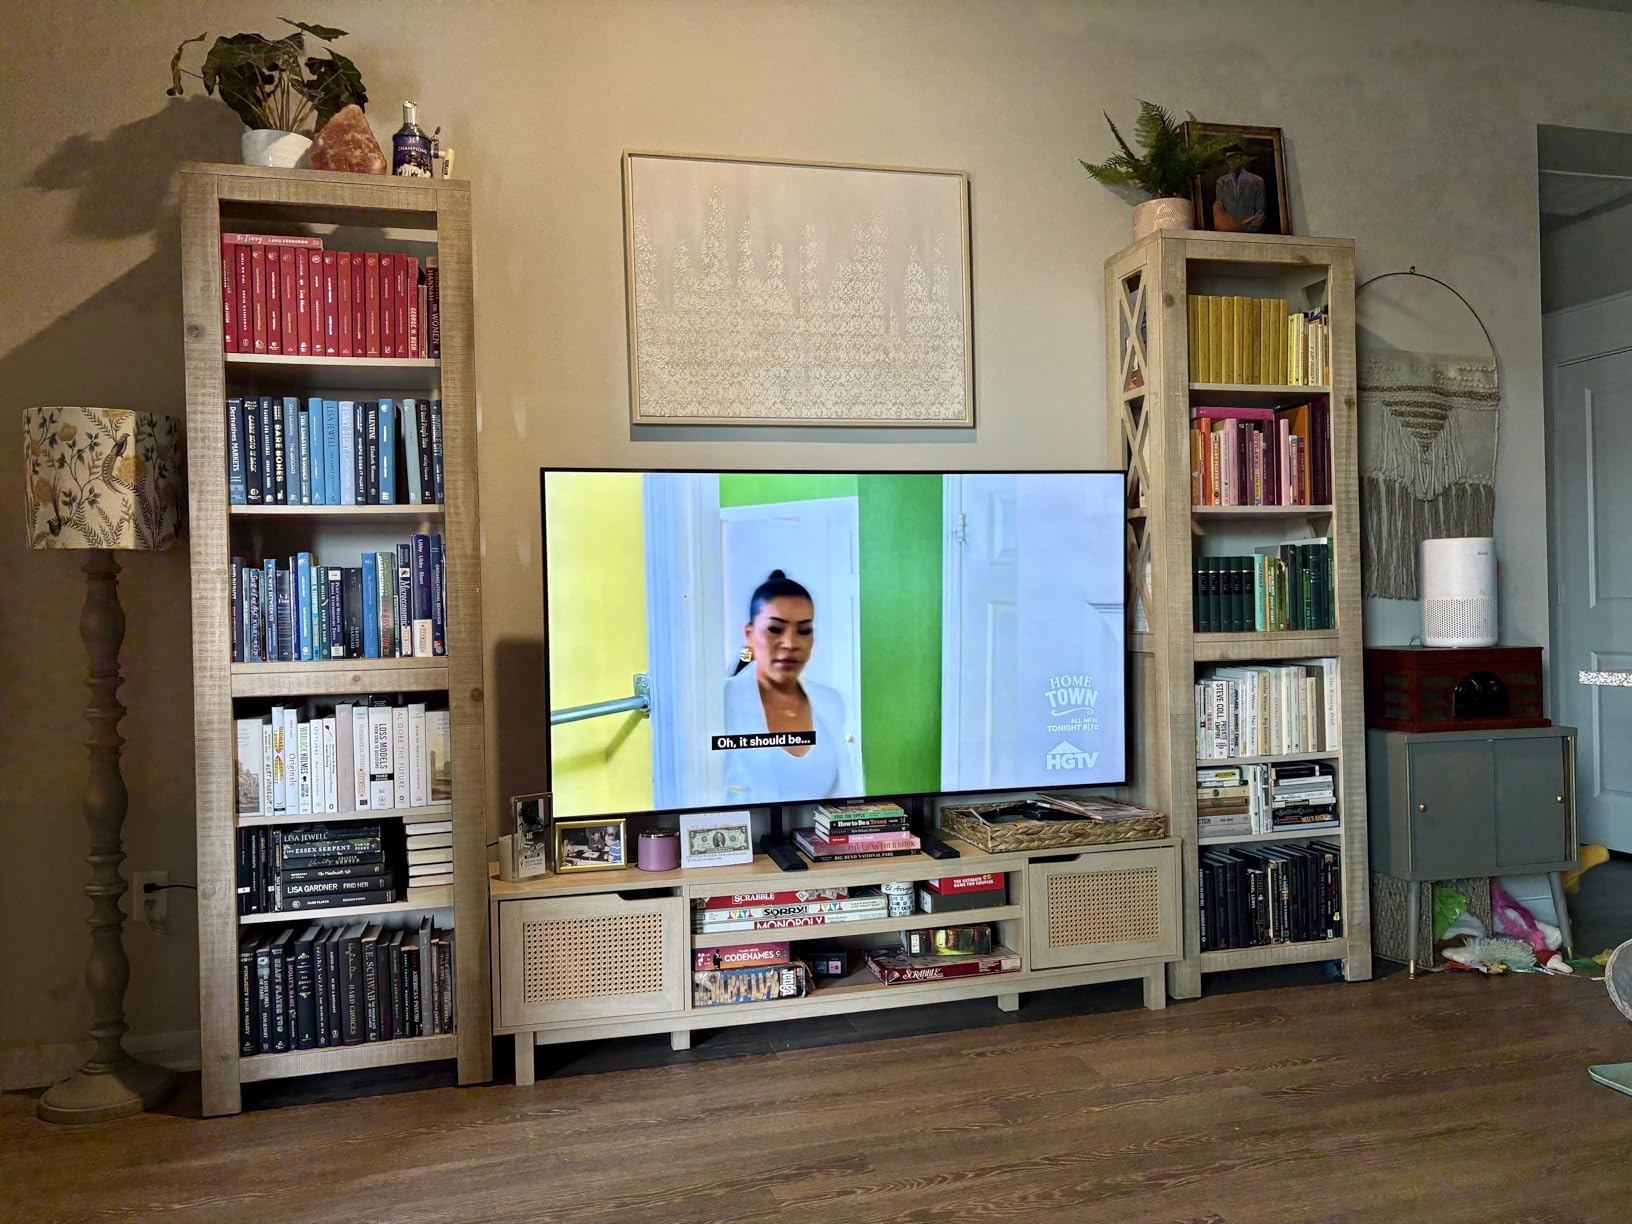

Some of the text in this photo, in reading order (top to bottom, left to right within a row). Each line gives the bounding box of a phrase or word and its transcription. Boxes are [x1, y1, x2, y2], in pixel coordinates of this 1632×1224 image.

[327, 423, 335, 449] JEWELL
[342, 406, 351, 451] FUNNY STORY
[230, 406, 240, 472] Derivatives MARKETS
[433, 443, 442, 456] CITY
[275, 450, 283, 482] BONES
[1049, 675, 1093, 690] HOME
[1044, 687, 1099, 707] TOWN
[1216, 683, 1224, 720] STEVE COLL
[1048, 724, 1081, 733] TONIGHT
[300, 726, 308, 752] WARLOCK
[379, 723, 388, 769] LOSS MODELS
[717, 734, 811, 748] Oh, it should be...
[287, 753, 296, 786] Originals
[300, 753, 309, 774] HOLMES
[1046, 752, 1099, 770] HGTV
[284, 833, 328, 842] LISA JEWELL
[318, 844, 351, 852] SERPENT
[287, 886, 303, 894] LISA
[304, 883, 338, 892] GARDNER
[734, 893, 775, 903] SCRABBLE
[763, 905, 808, 917] SORRY!
[724, 950, 774, 963] CODENAMES
[366, 961, 376, 1002] SCHWAB
[779, 969, 794, 997] Jenga
[902, 968, 942, 980] SCRABBLE
[274, 958, 284, 1032] READY PLAYER TWO
[349, 1005, 357, 1035] CHOICES
